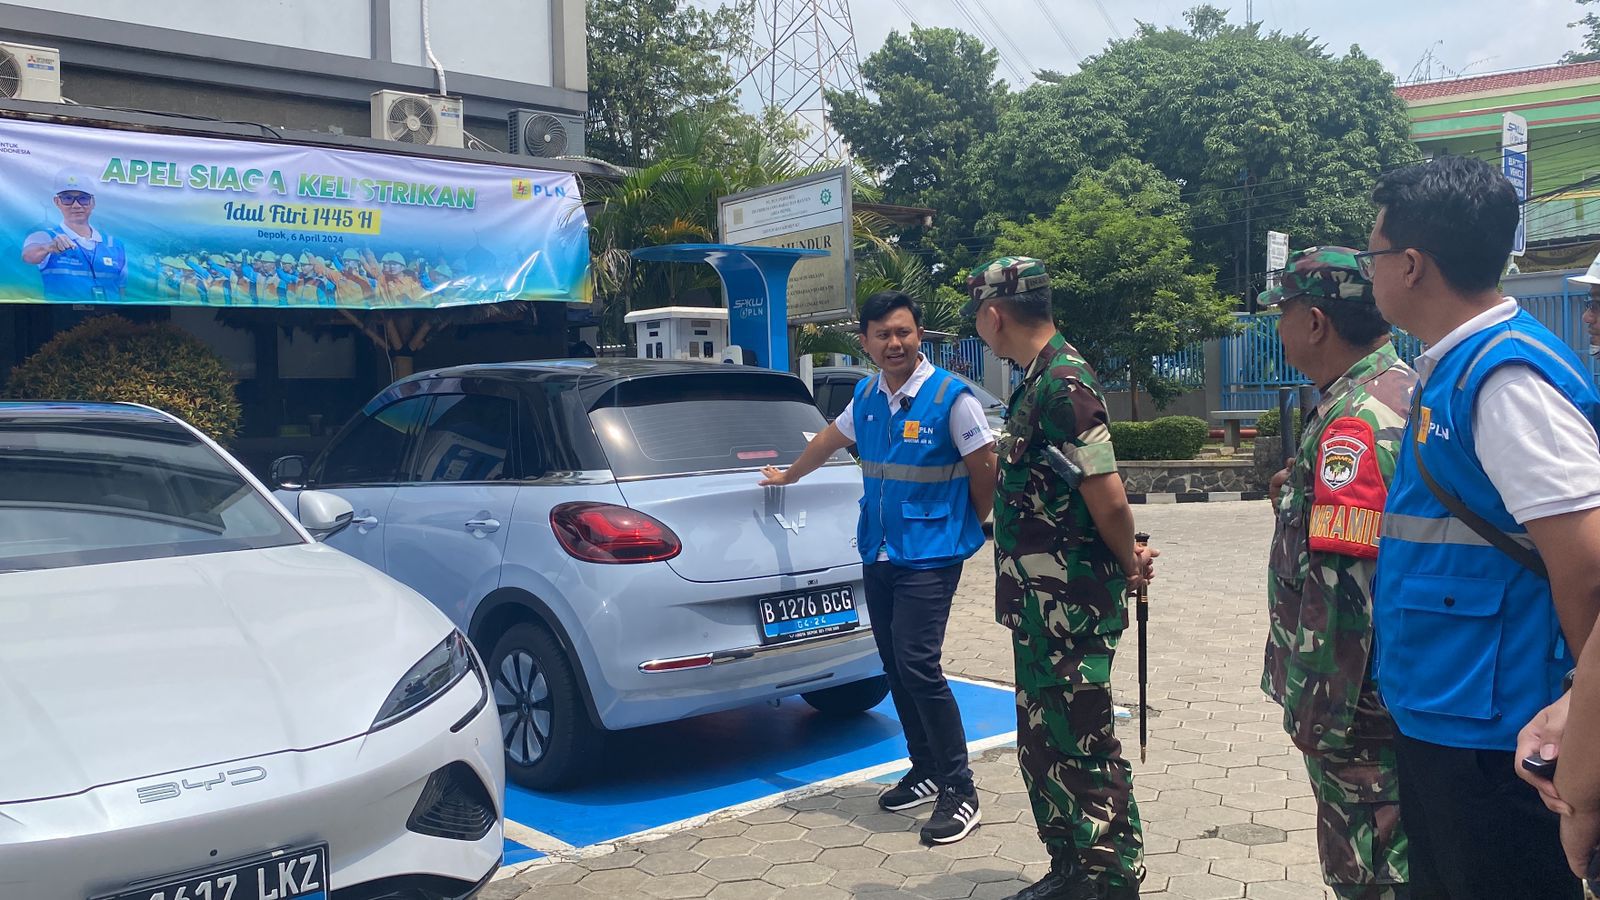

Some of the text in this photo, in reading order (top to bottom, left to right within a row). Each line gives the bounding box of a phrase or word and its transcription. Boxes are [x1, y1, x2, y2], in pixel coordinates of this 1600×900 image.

[101, 157, 287, 195] APEL SIAGA
[533, 185, 566, 197] PLN
[223, 201, 373, 229] Idul Fitri 1445 H
[257, 229, 344, 244] Depok, 6 April 2024
[747, 308, 764, 317] PLN
[918, 426, 934, 435] PLN
[1428, 422, 1449, 440] PLN
[764, 590, 852, 623] B 1276 BCG
[136, 765, 267, 804] BYD
[149, 853, 319, 900] 17 LKZ
